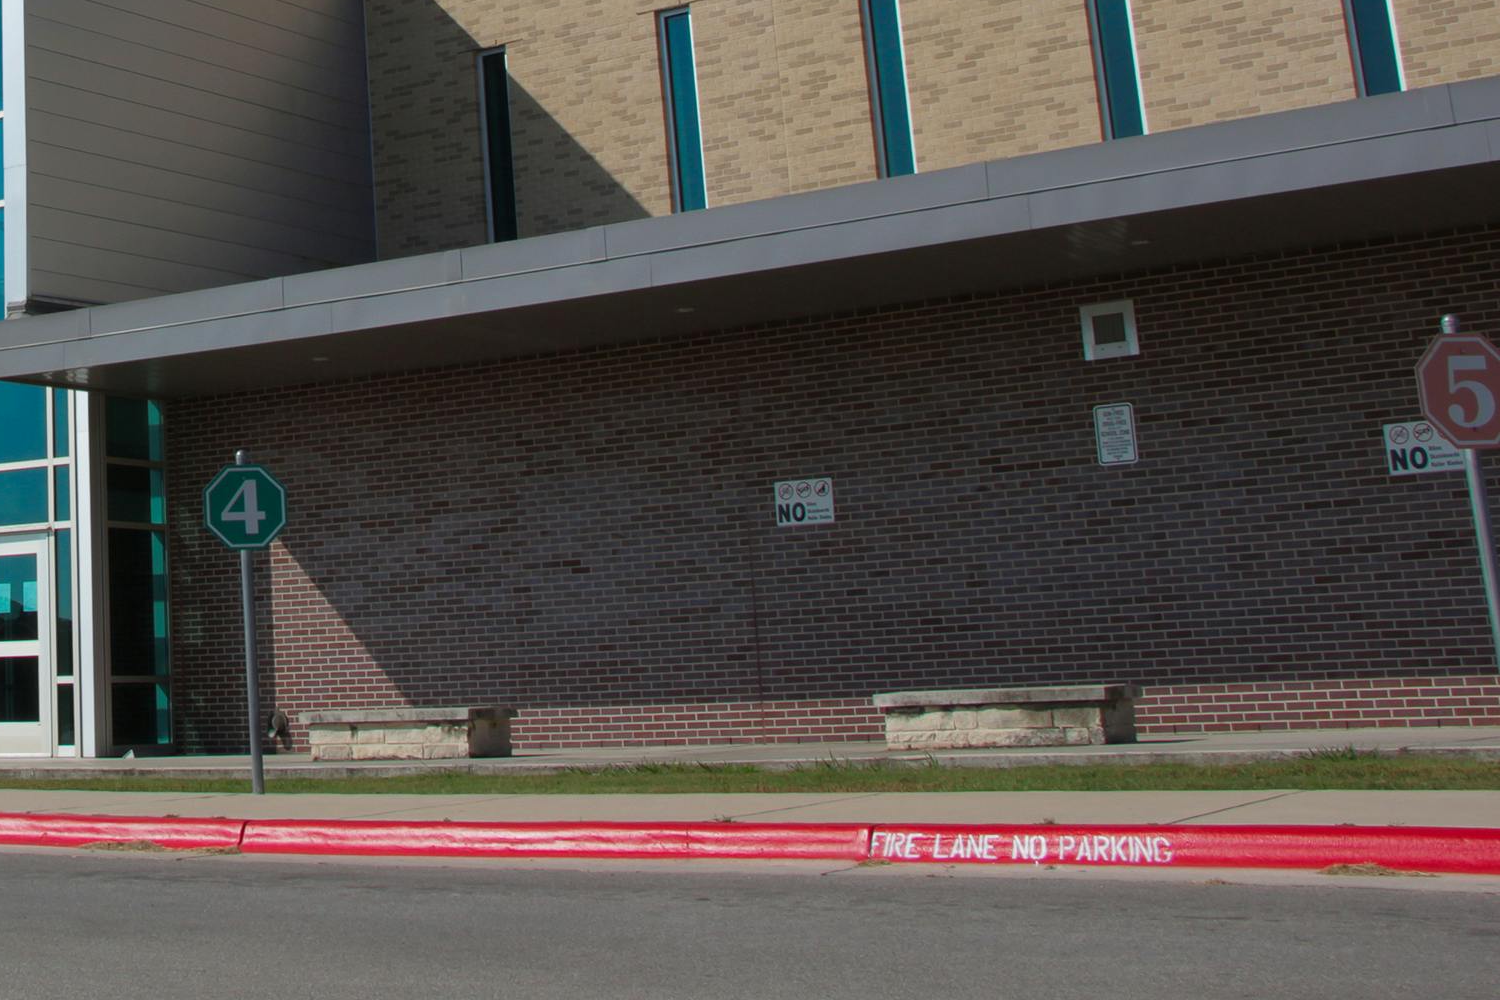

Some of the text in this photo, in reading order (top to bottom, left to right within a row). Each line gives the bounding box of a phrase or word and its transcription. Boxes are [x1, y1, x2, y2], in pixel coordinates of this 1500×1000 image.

[1447, 355, 1496, 429] 5
[1389, 446, 1429, 472] NO
[221, 479, 266, 534] 4
[777, 501, 806, 523] NO
[869, 831, 1174, 863] FIRE LANE NO PARKING
